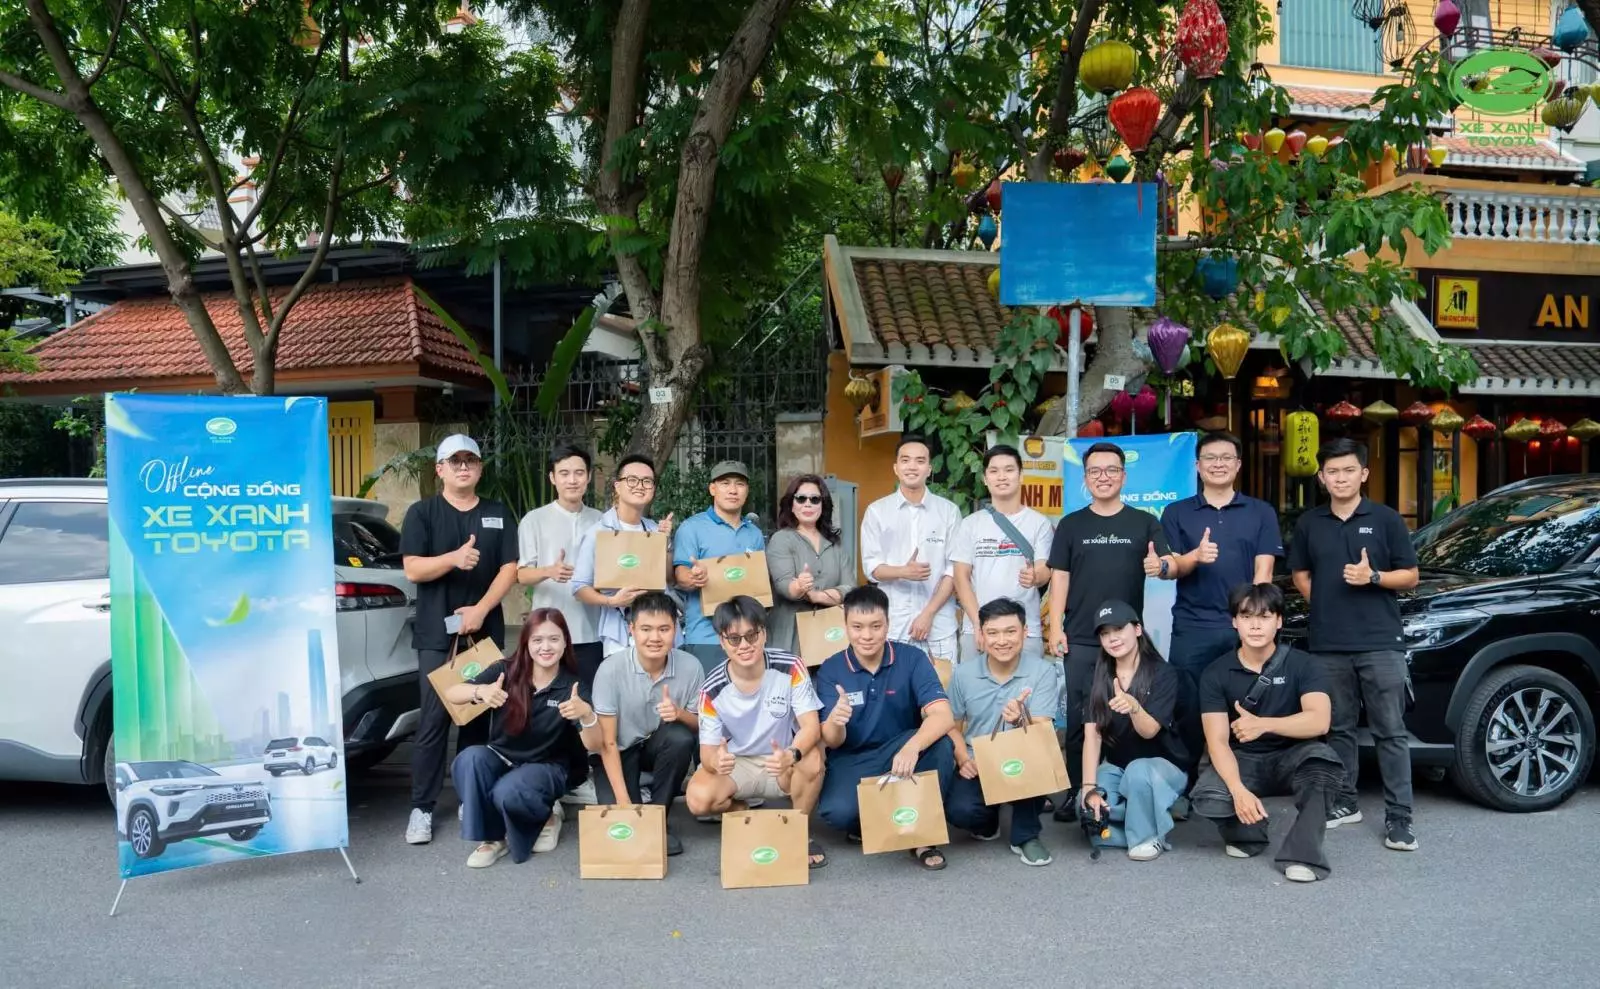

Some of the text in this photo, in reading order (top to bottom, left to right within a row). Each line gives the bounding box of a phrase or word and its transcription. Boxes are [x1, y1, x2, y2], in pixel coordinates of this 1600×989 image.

[1536, 294, 1589, 329] AN
[139, 456, 215, 494] Offline
[183, 481, 301, 499] CỘNG ĐỒNG
[1020, 484, 1064, 508] NH M
[1142, 490, 1177, 502] ĐỒNG
[142, 503, 310, 528] XE XANH
[143, 531, 310, 554] TOYOTA
